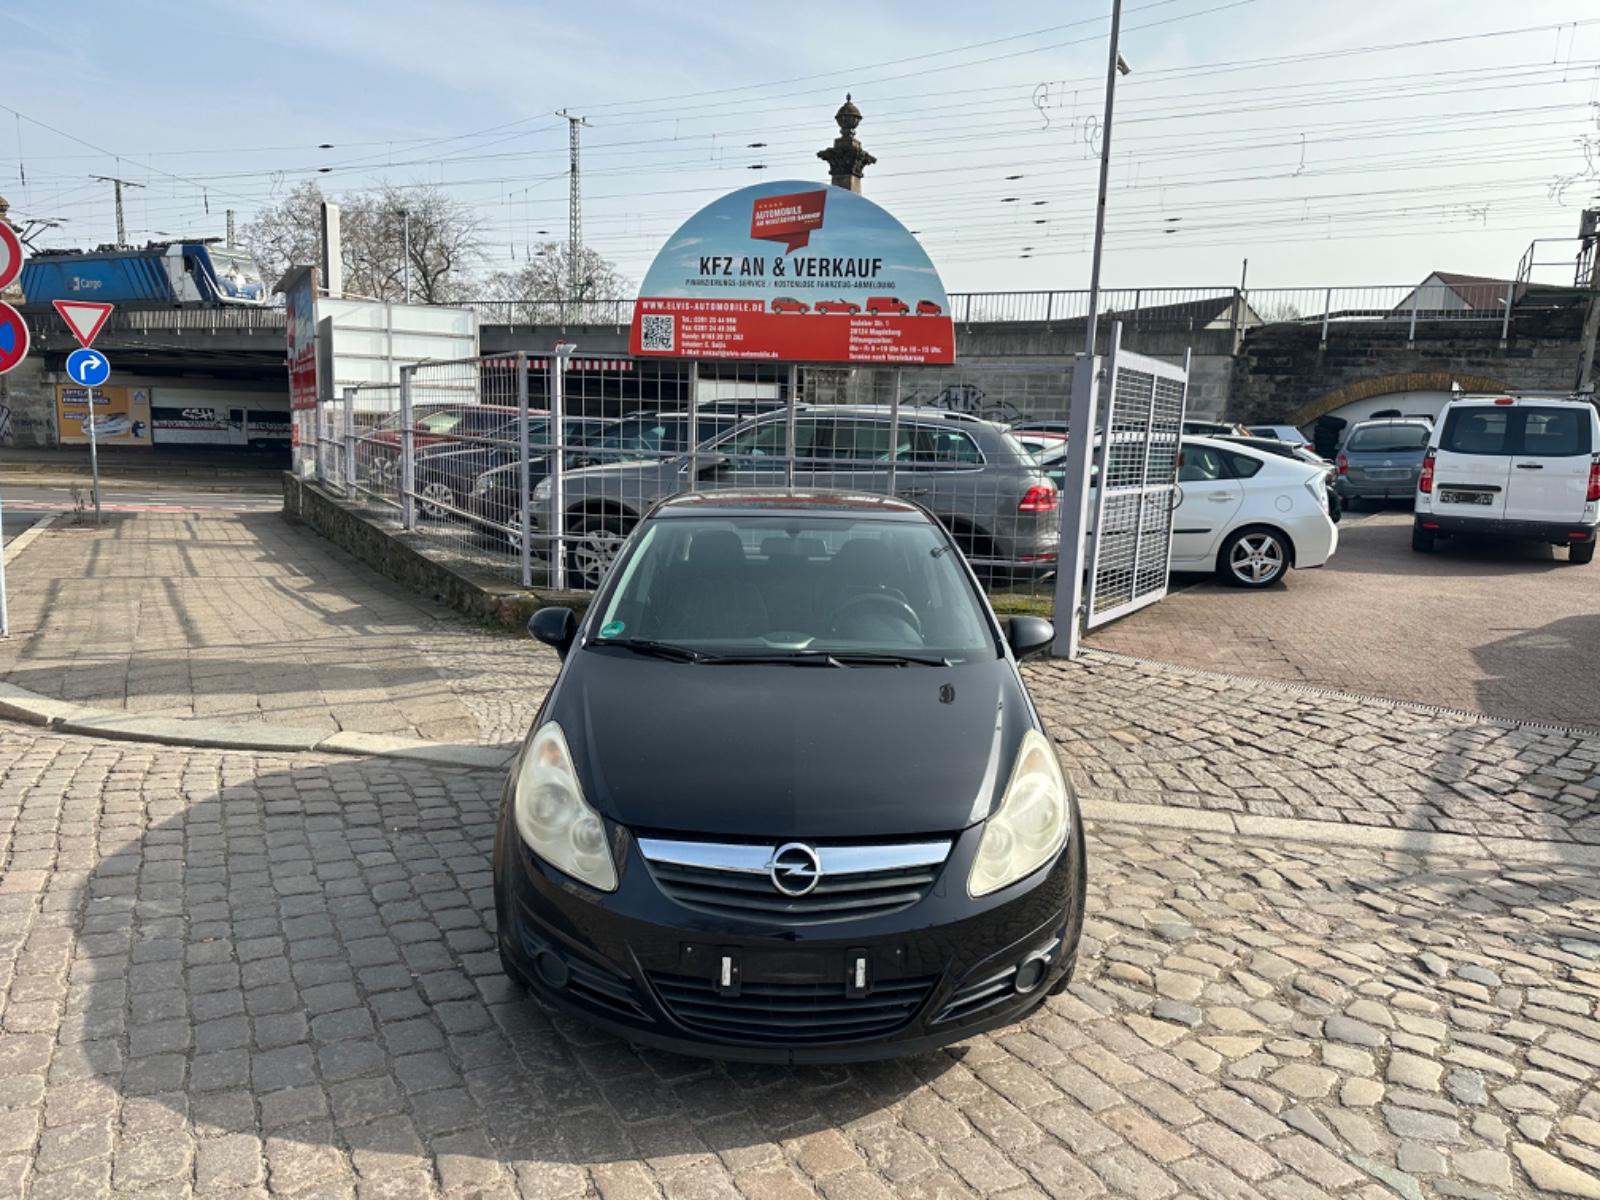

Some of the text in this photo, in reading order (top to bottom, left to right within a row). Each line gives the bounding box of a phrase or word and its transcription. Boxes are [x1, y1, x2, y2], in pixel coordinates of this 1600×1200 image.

[699, 256, 882, 278] KFZ AN & VERKAUF
[80, 278, 103, 290] Cargo
[685, 279, 766, 288] FINANZIERUNGS-SERVICE
[774, 280, 814, 288] KOSTENLOSE
[817, 281, 896, 289] FAHRZEUG-ABMELDUNG
[642, 301, 763, 312] WWW.ELVIS-AUTOMOBILE.DE
[869, 328, 901, 336] Magdeburg
